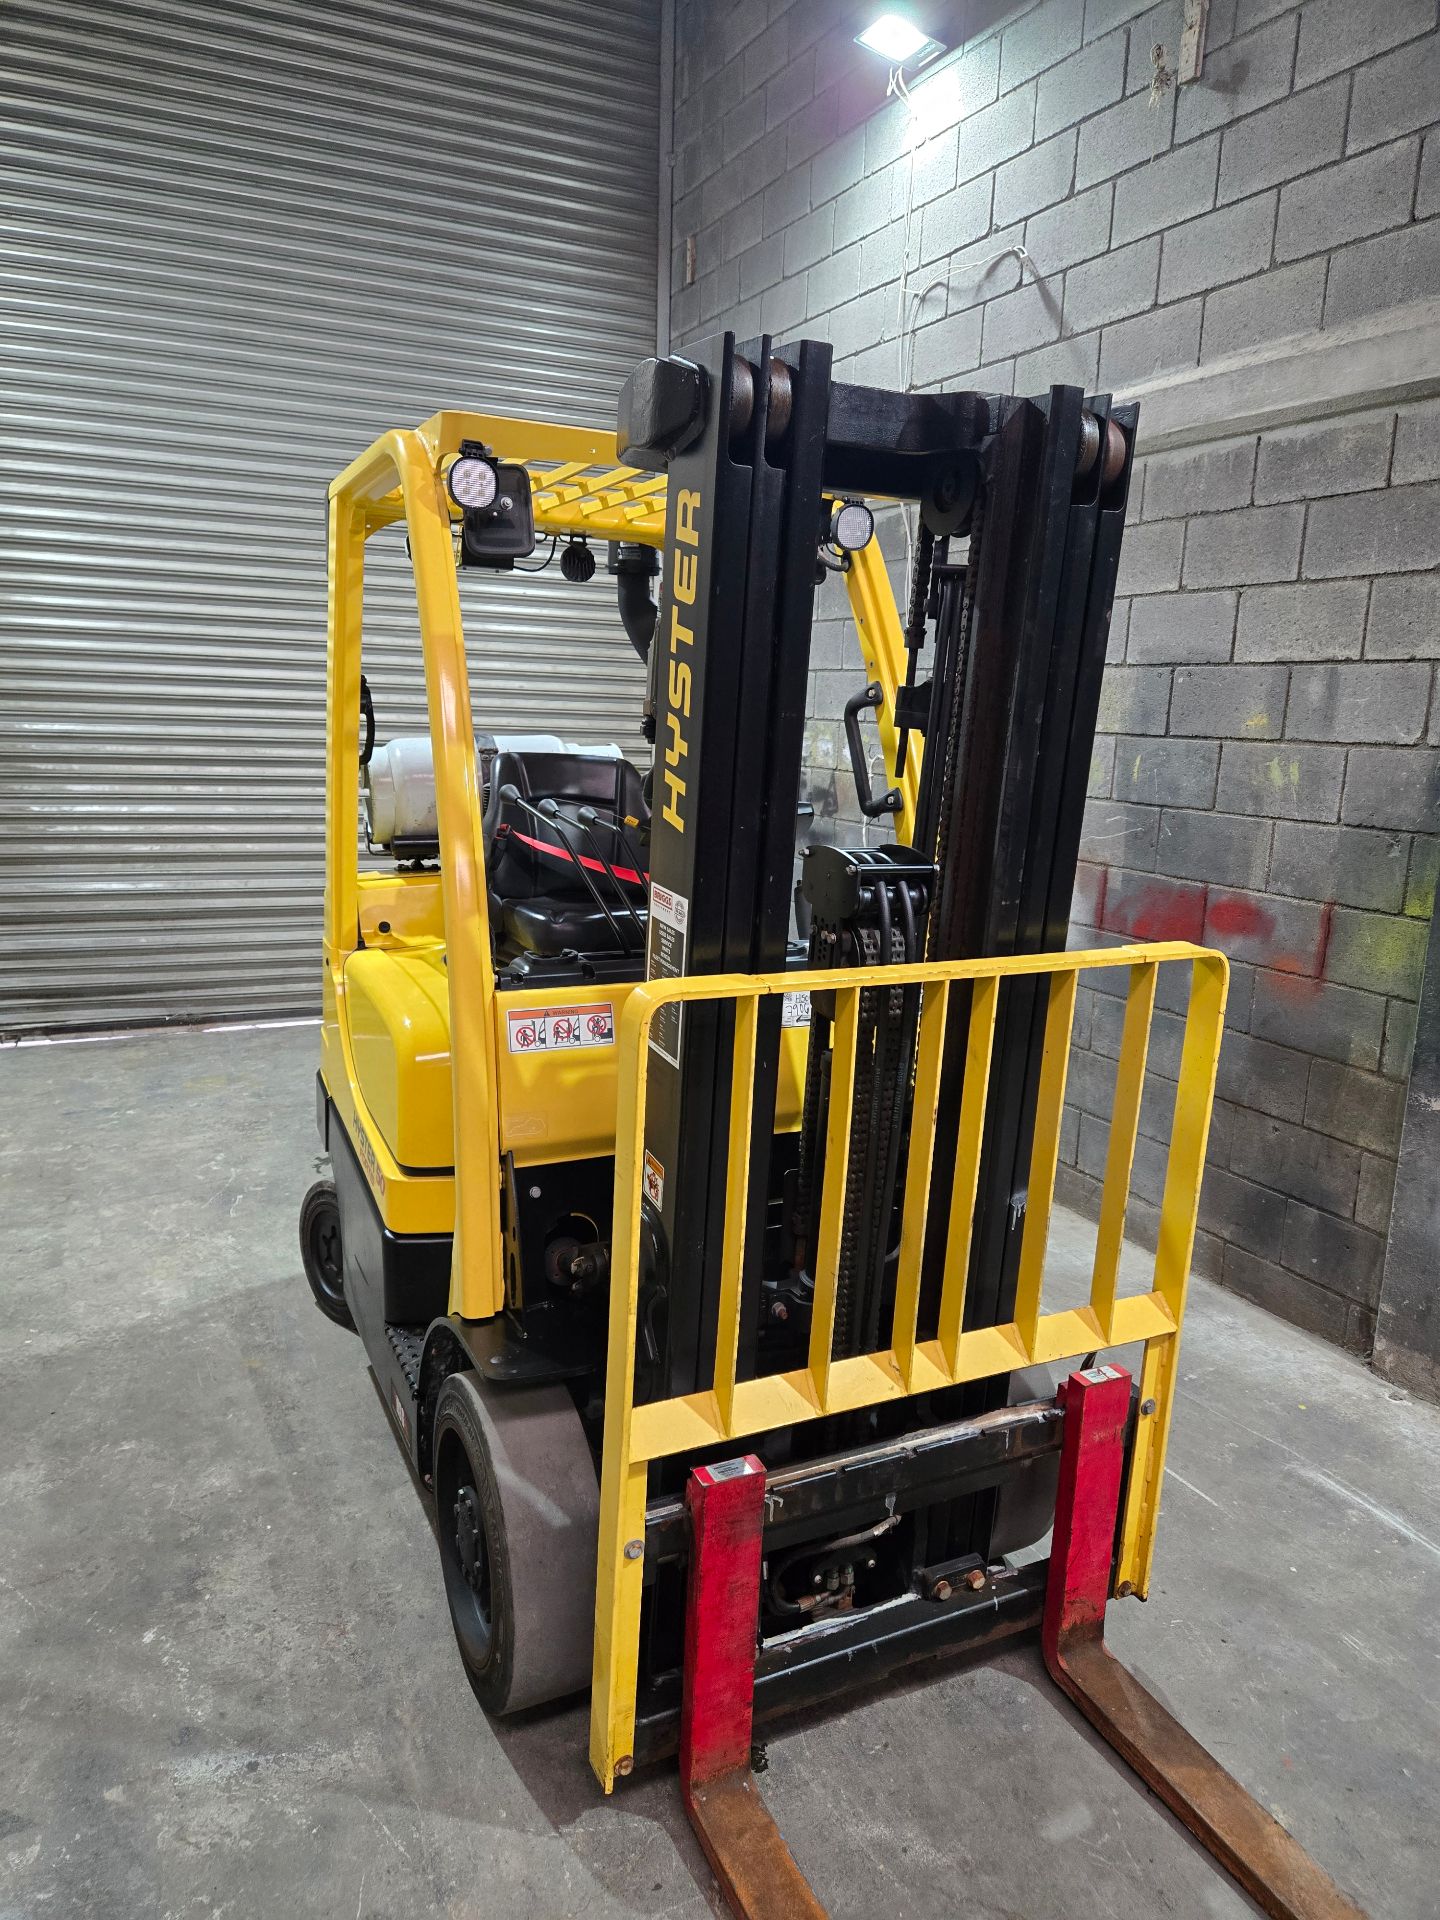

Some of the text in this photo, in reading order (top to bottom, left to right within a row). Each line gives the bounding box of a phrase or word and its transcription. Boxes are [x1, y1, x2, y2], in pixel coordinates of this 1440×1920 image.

[662, 488, 701, 834] HYSTER
[654, 891, 671, 906] BRIGGS
[353, 1109, 375, 1174] HYSTER
